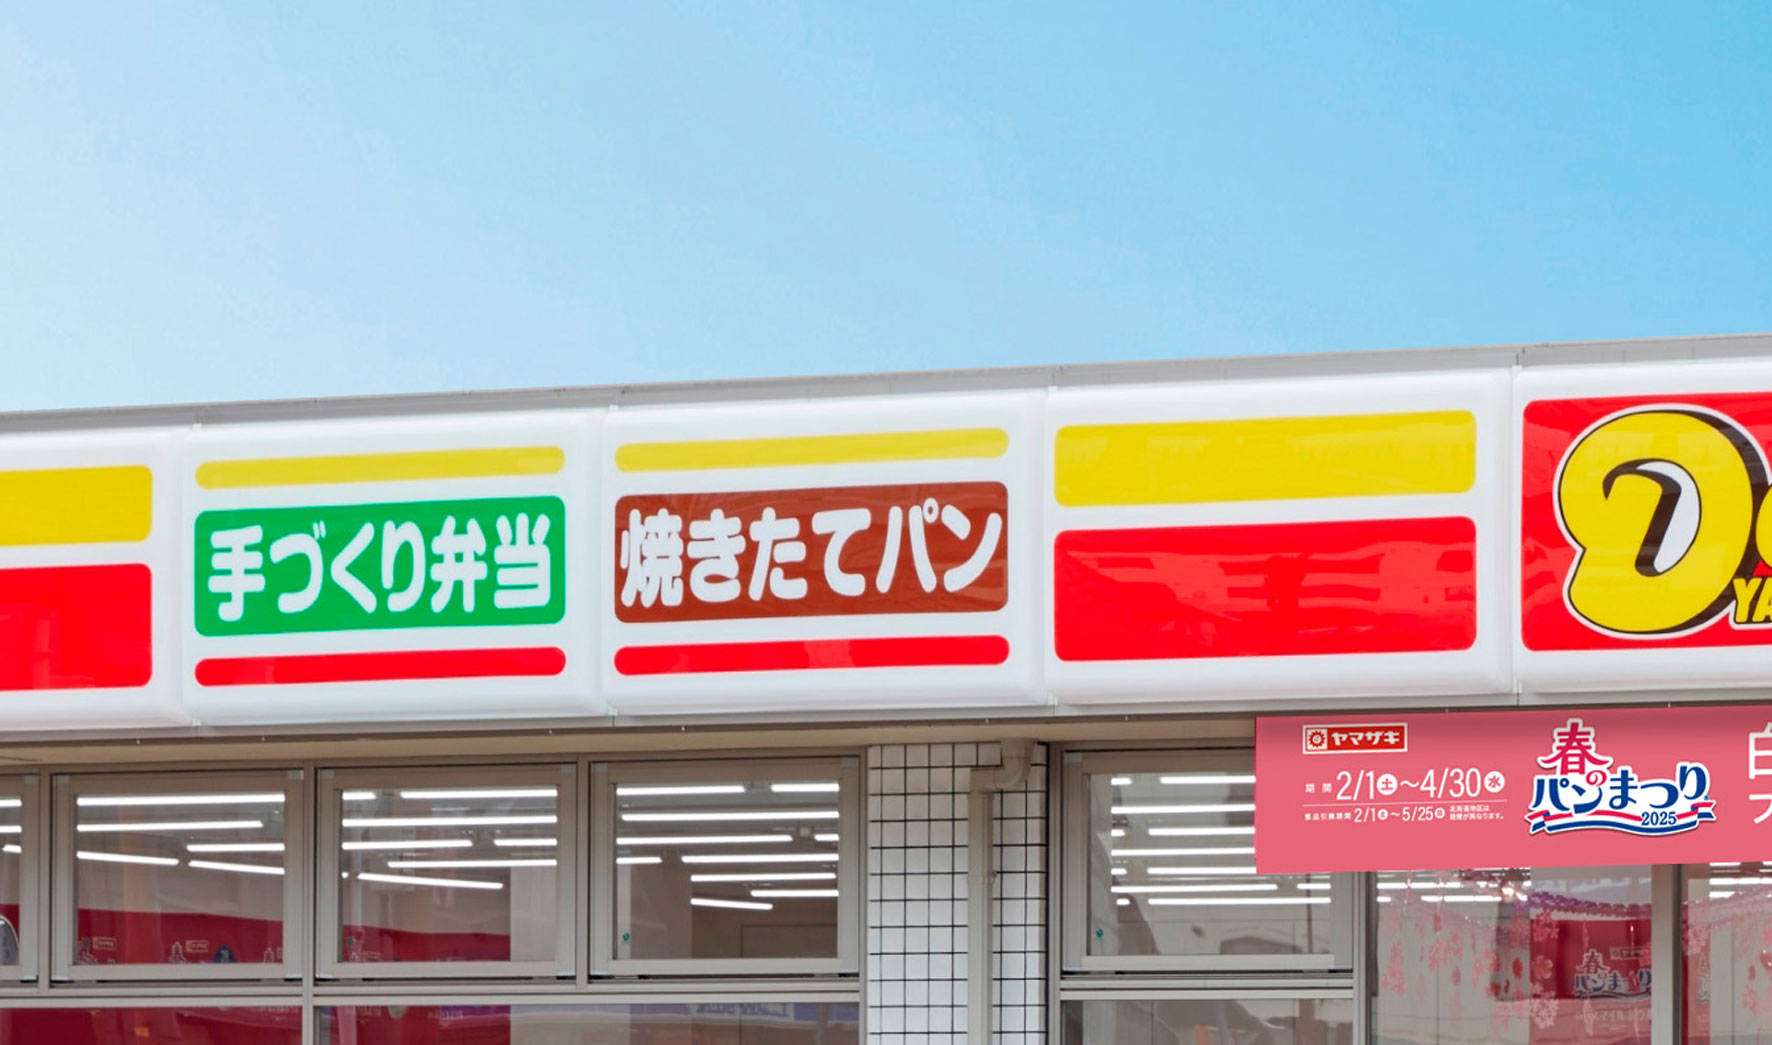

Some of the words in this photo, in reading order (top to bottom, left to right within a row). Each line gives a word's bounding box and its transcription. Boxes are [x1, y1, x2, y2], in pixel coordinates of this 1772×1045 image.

[208, 513, 551, 621] 手づくり弁当
[621, 497, 1002, 607] 焼きたてパン
[1331, 730, 1400, 746] ヤマザキ
[1532, 763, 1709, 815] パンまつり
[1641, 812, 1677, 825] 2025
